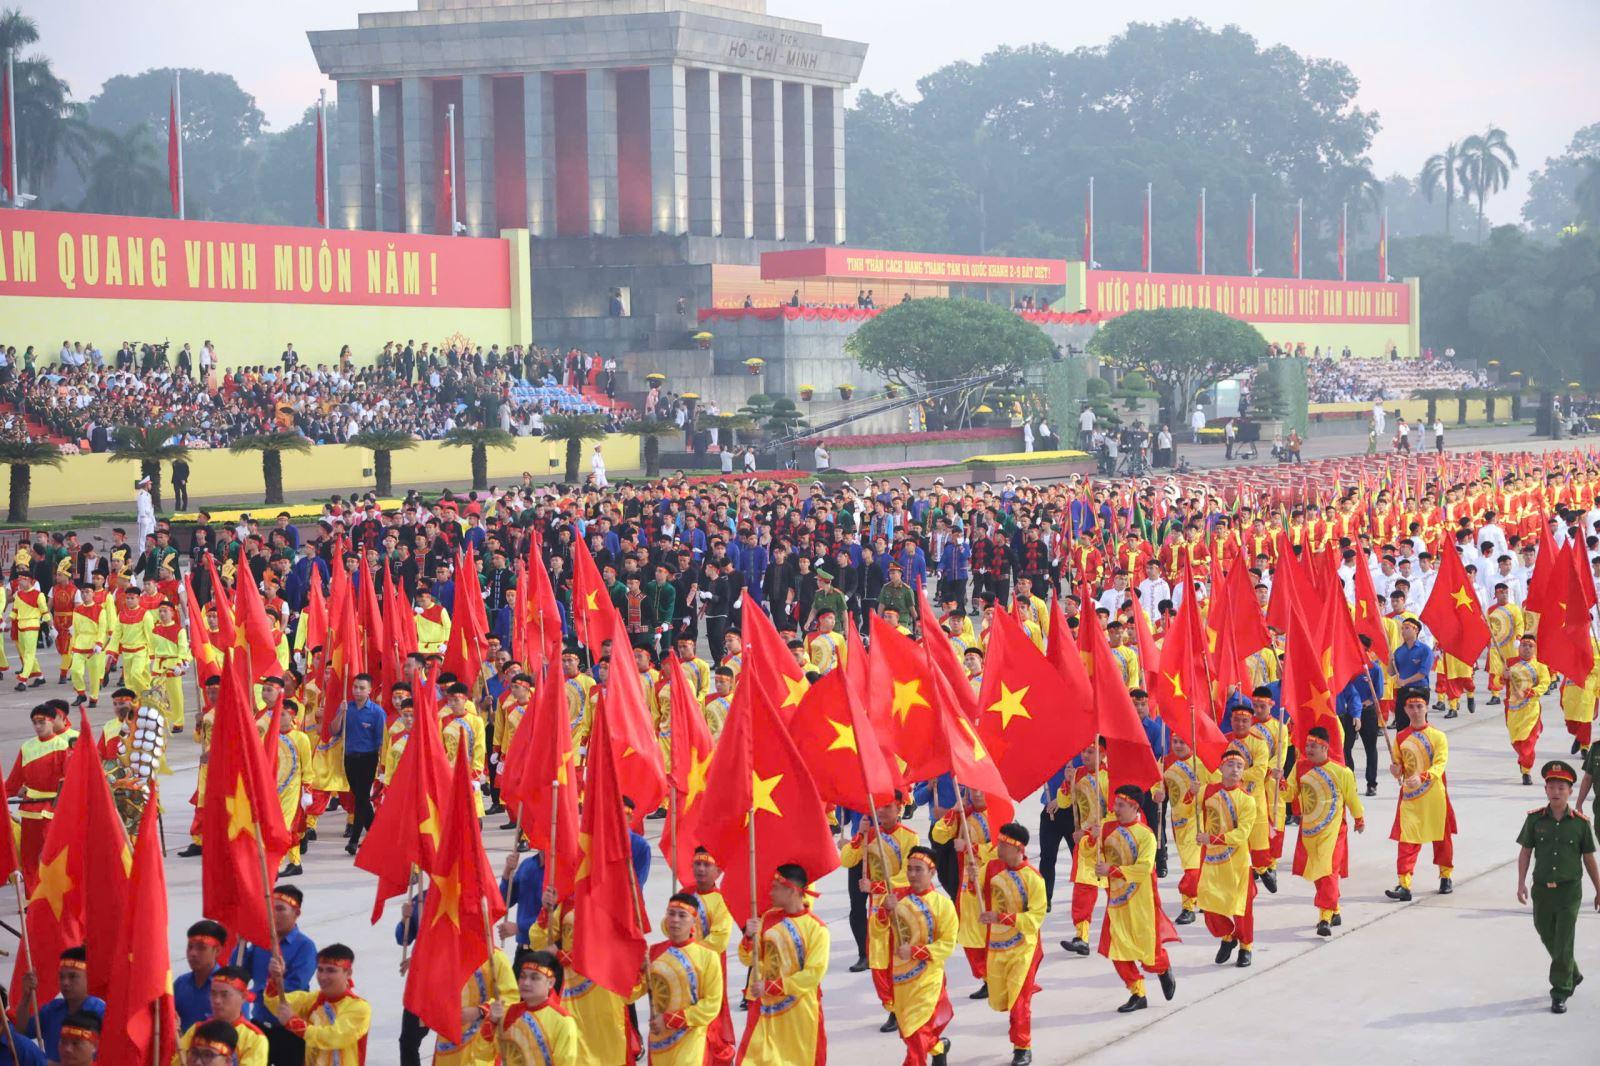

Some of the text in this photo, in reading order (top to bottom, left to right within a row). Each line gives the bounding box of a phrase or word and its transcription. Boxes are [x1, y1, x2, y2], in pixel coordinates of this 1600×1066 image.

[58, 232, 167, 290] QUANG
[185, 240, 257, 290] VINH
[275, 238, 352, 293] MUÔN
[1097, 277, 1130, 312] NƯỚC
[1240, 280, 1260, 315] CHỦ
[1264, 284, 1295, 316] NGHĨA
[1299, 285, 1320, 320] VIỆT
[1323, 289, 1343, 316] NAM
[1346, 286, 1372, 317] MUÔN
